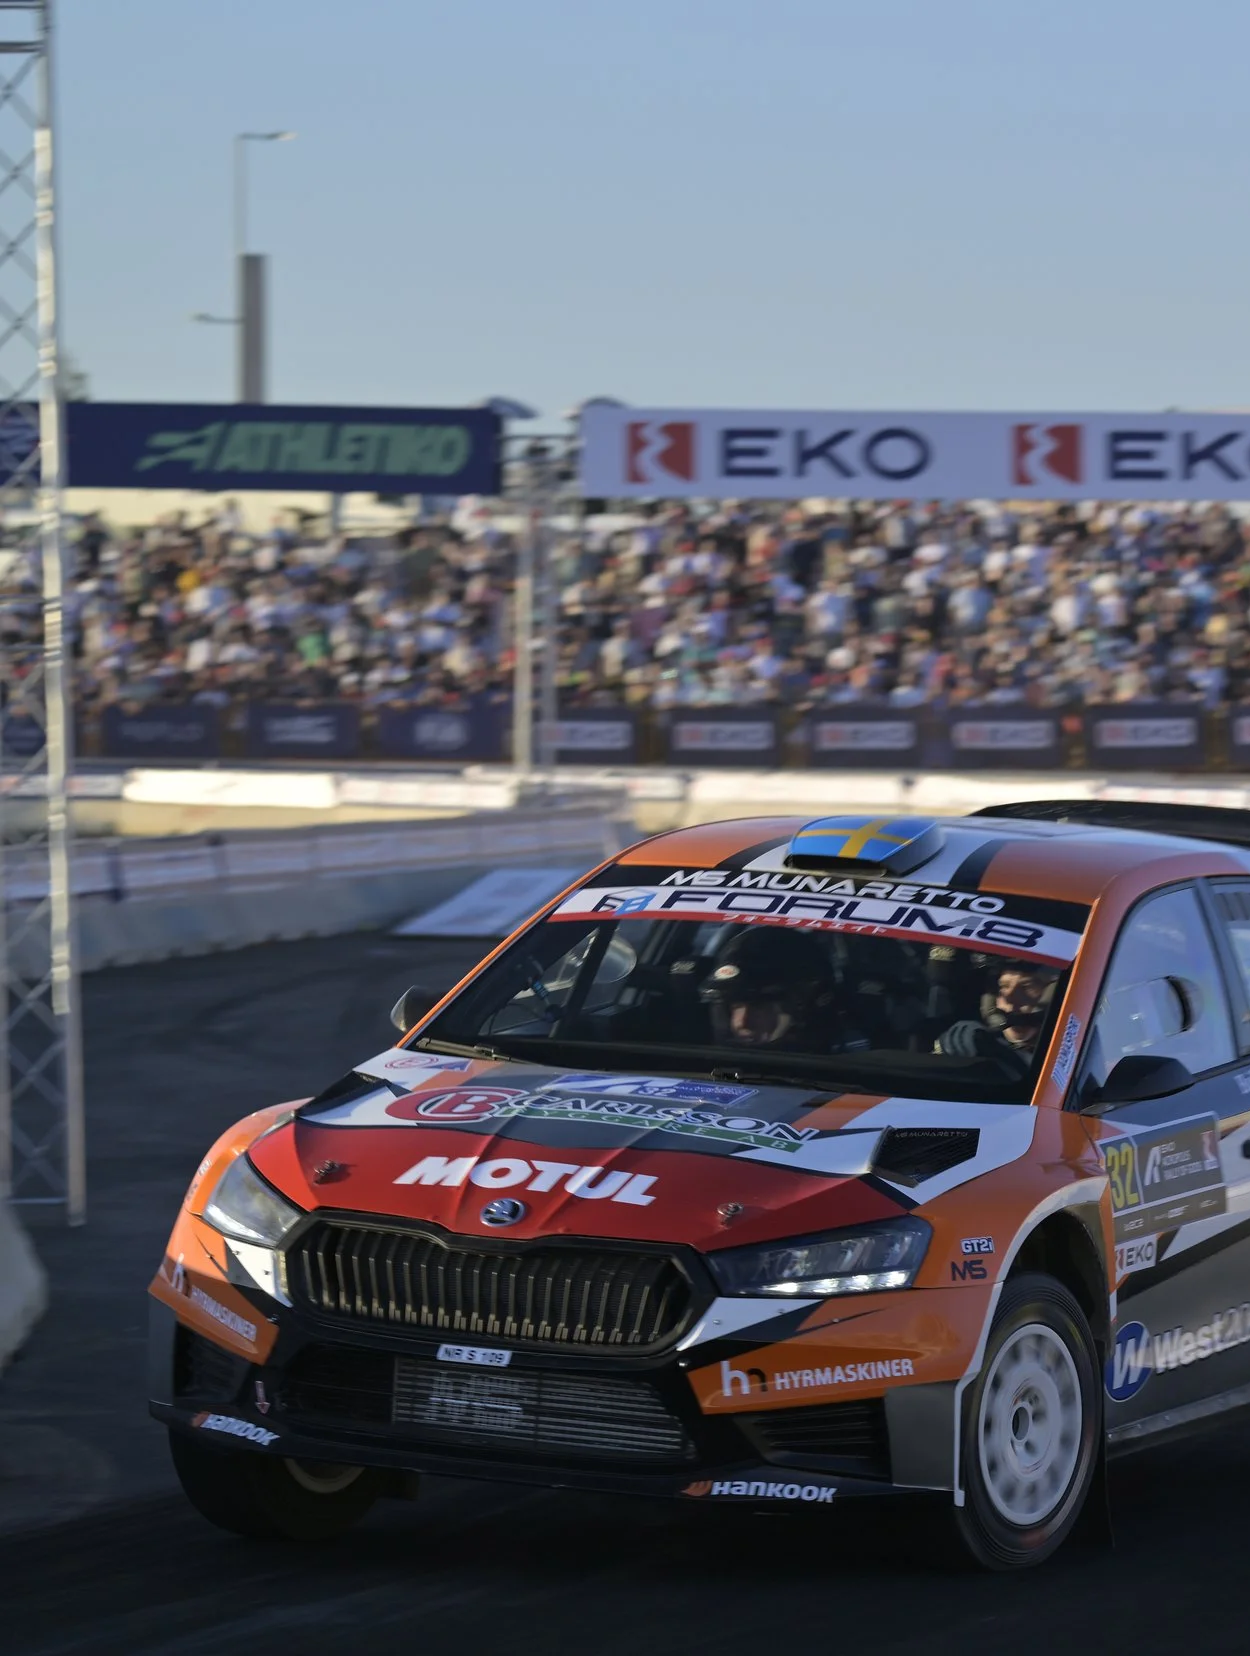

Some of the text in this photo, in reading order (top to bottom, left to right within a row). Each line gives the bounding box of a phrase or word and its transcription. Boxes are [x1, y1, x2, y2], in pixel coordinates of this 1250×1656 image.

[720, 427, 932, 481] EKO
[728, 871, 1005, 913] MUNARETTO
[660, 889, 1044, 948] FORUM8
[637, 1085, 677, 1097] 32
[508, 1092, 820, 1143] CARLSSON
[740, 1132, 790, 1151] AB
[393, 1156, 659, 1205] MOTUL
[1106, 1142, 1139, 1209] 32
[1126, 1242, 1155, 1267] EKO
[467, 1349, 476, 1361] S
[774, 1358, 914, 1390] HYRMASKINER
